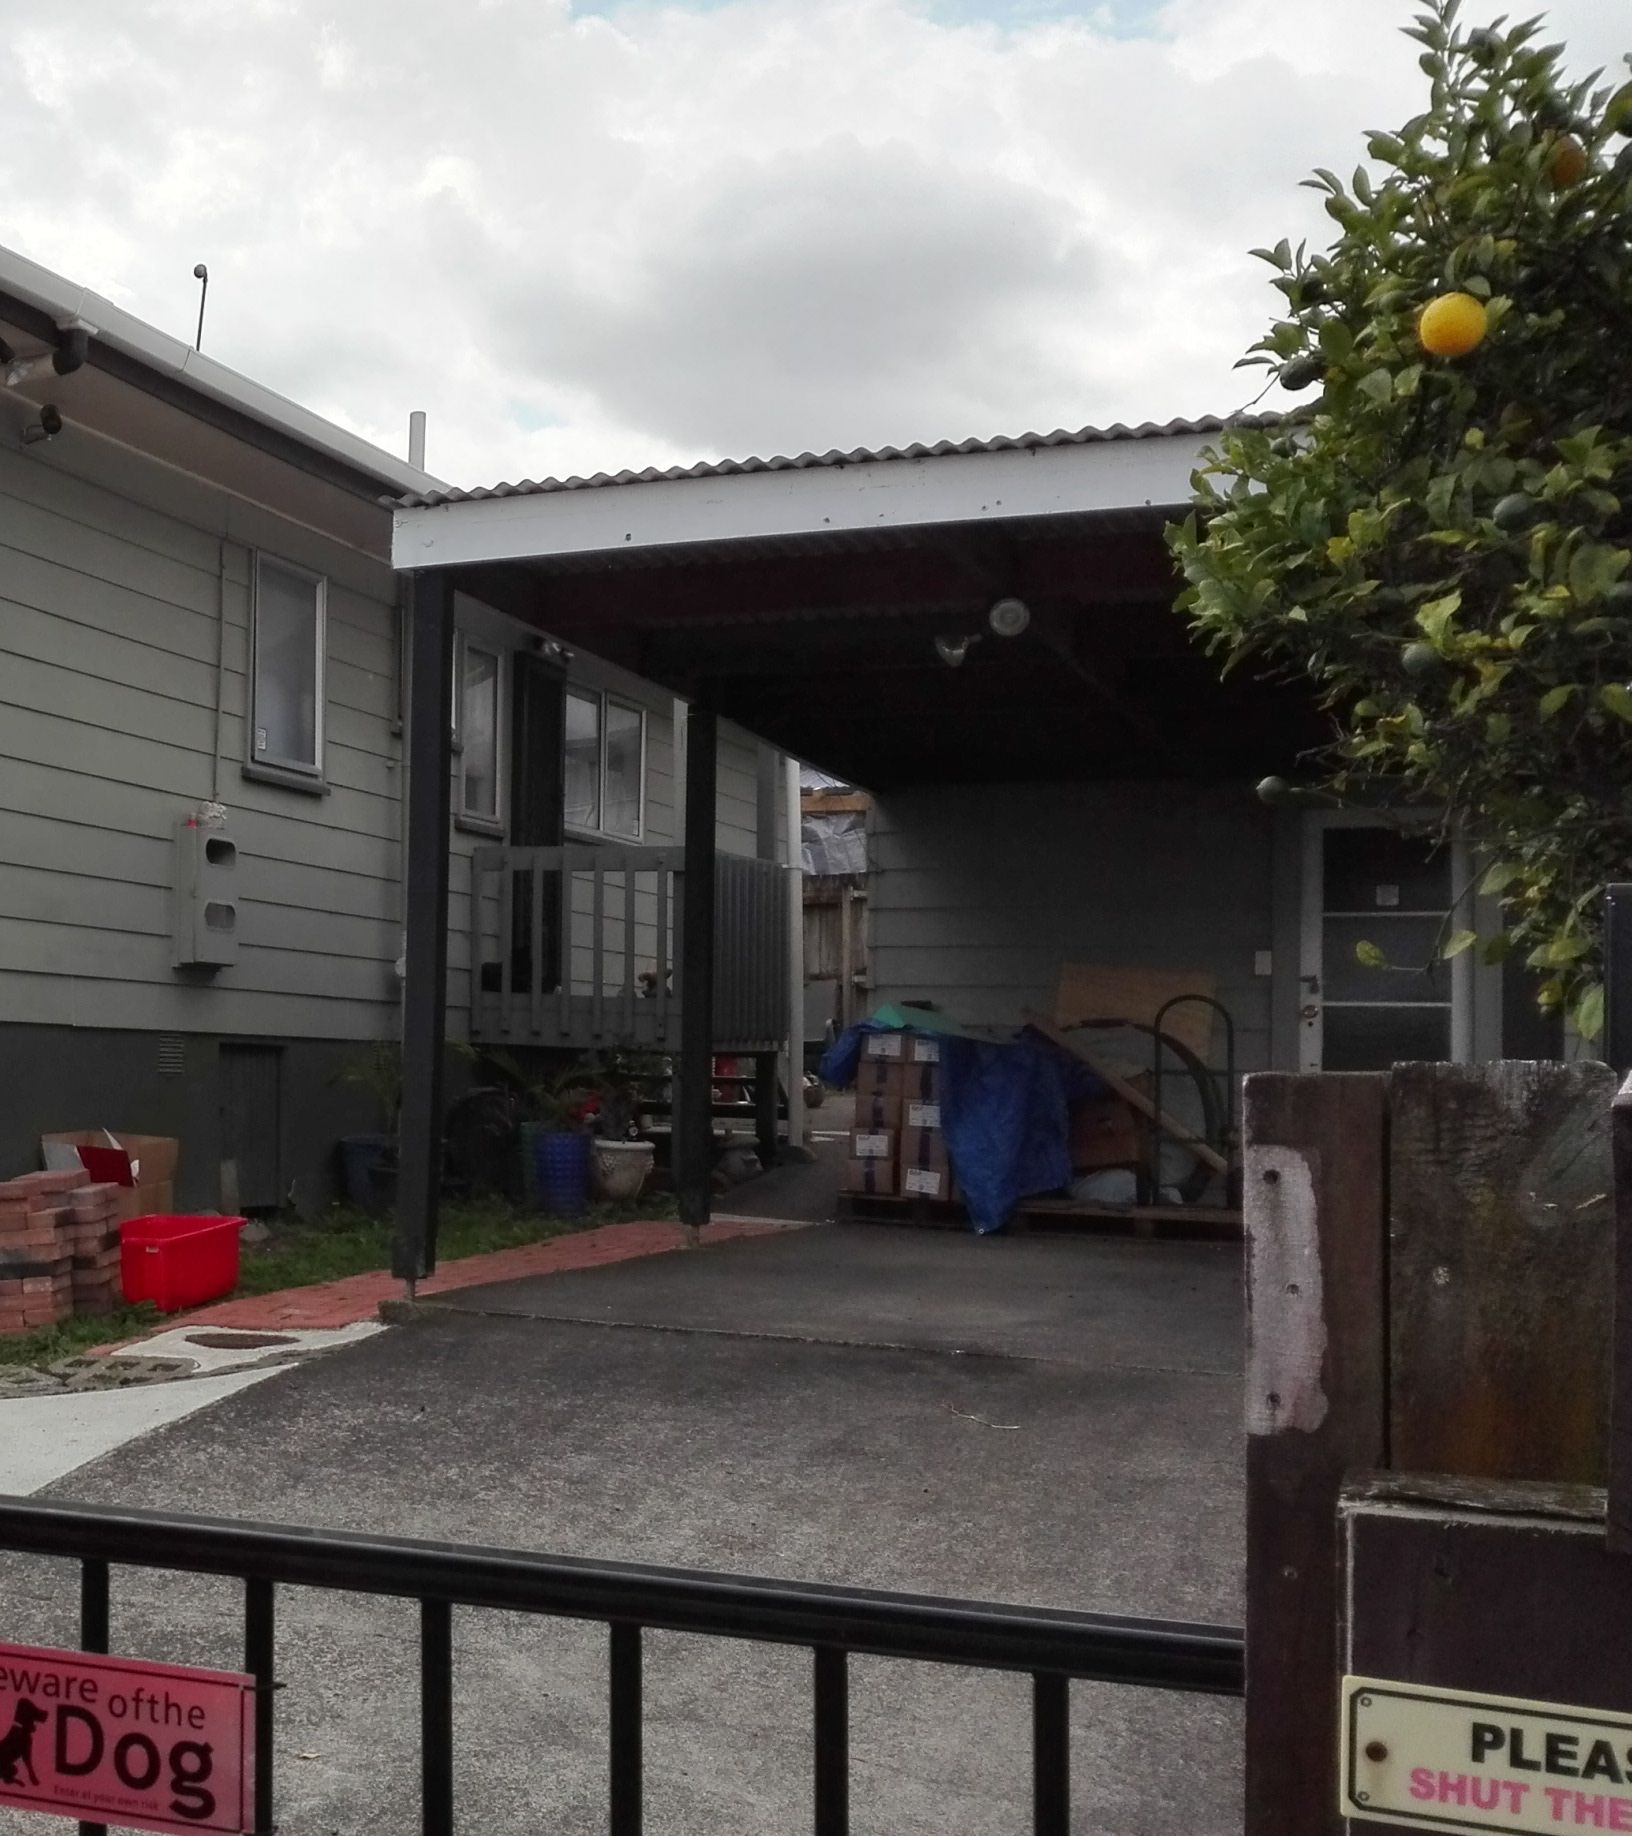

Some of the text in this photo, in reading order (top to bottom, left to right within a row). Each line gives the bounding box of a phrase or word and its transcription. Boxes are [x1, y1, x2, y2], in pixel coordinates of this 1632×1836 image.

[55, 1704, 216, 1820] Dog
[1472, 1722, 1632, 1784] PLEA
[1409, 1767, 1632, 1833] SHUT THE
